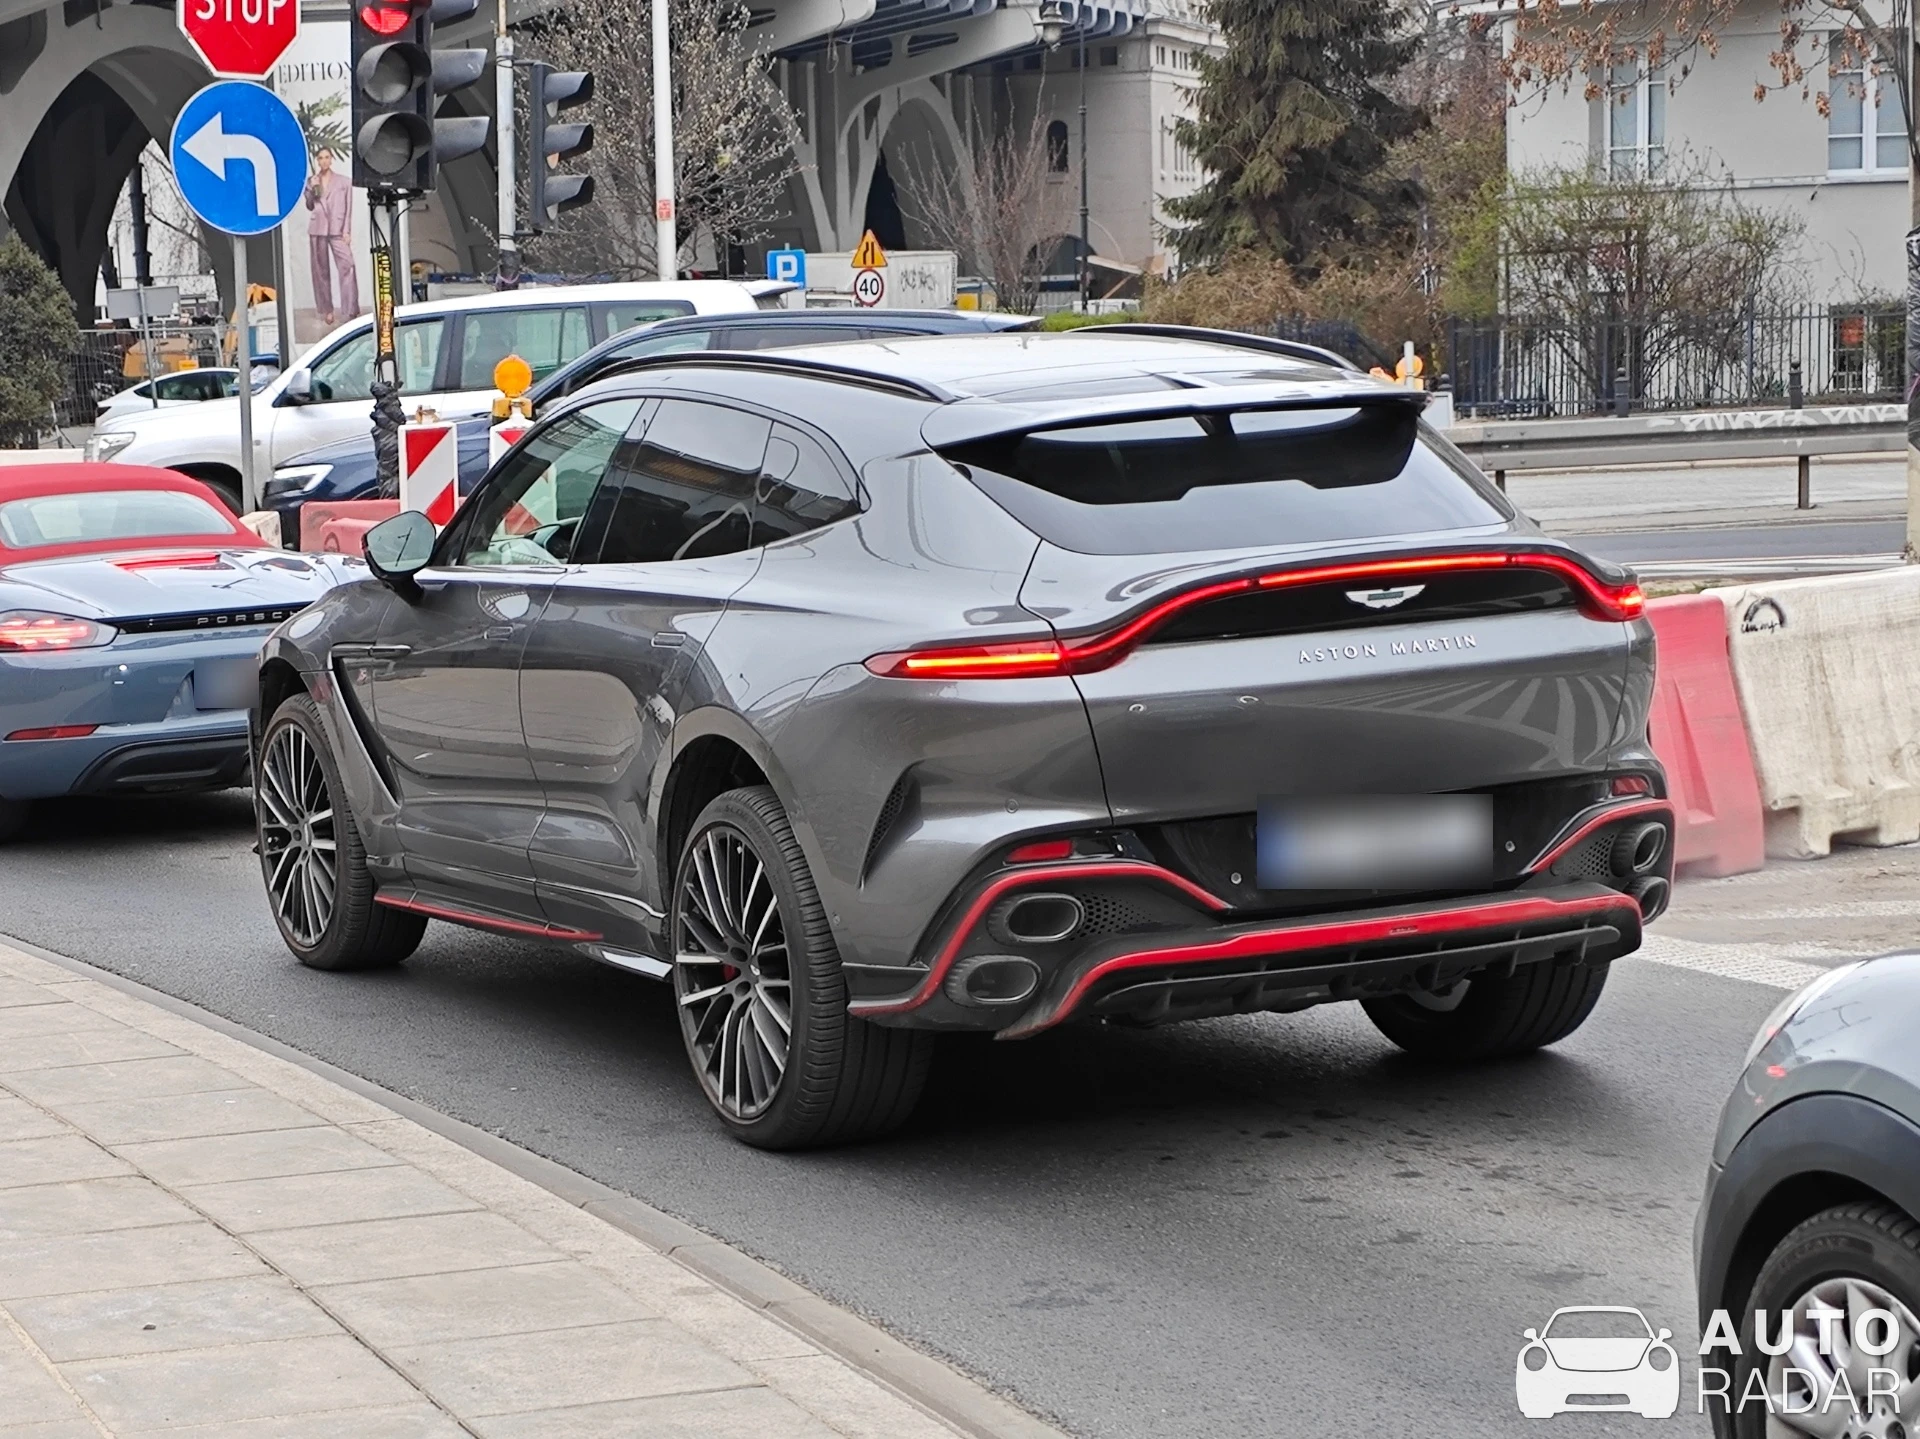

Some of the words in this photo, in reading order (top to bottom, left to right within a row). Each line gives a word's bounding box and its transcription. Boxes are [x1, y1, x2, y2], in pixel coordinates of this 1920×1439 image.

[195, 0, 288, 26] STOP
[776, 254, 798, 281] P
[859, 277, 880, 296] 40
[1299, 643, 1377, 664] ASTON
[1391, 634, 1477, 656] MARTIN
